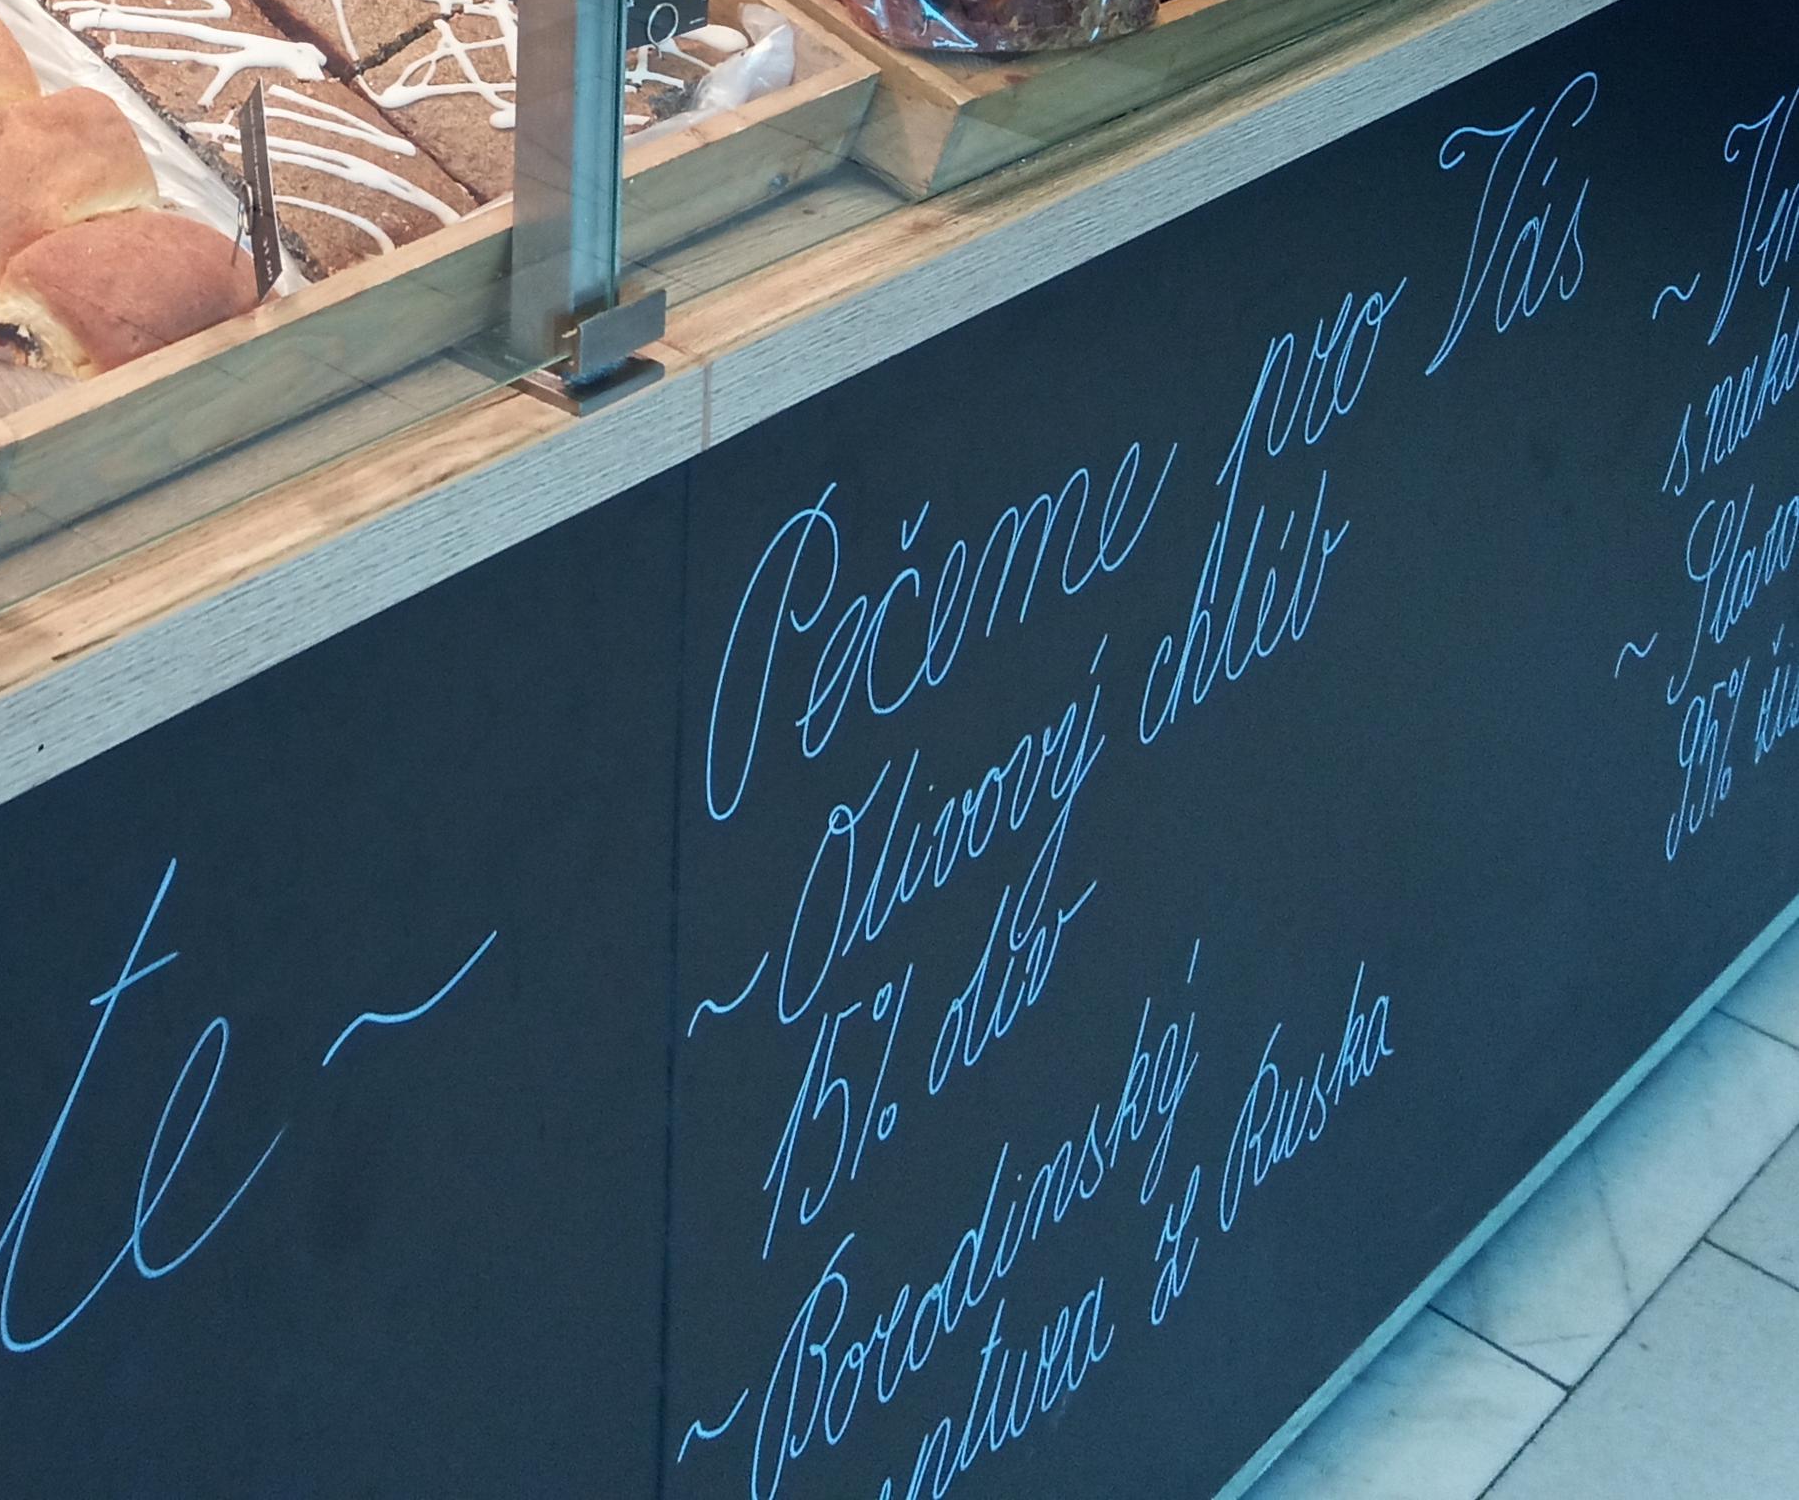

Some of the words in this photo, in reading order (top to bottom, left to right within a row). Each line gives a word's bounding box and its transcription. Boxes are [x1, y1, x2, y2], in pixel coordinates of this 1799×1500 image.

[706, 441, 1177, 821] Pečeme
[1217, 278, 1407, 487] pro
[1426, 72, 1598, 374] Vás
[778, 634, 1106, 1023] Olivový
[1141, 471, 1350, 745] chléb
[752, 939, 1199, 1500] Borodinský
[764, 963, 913, 1260] 15%
[930, 880, 1098, 1095] oliv
[1220, 963, 1394, 1232] Ruska
